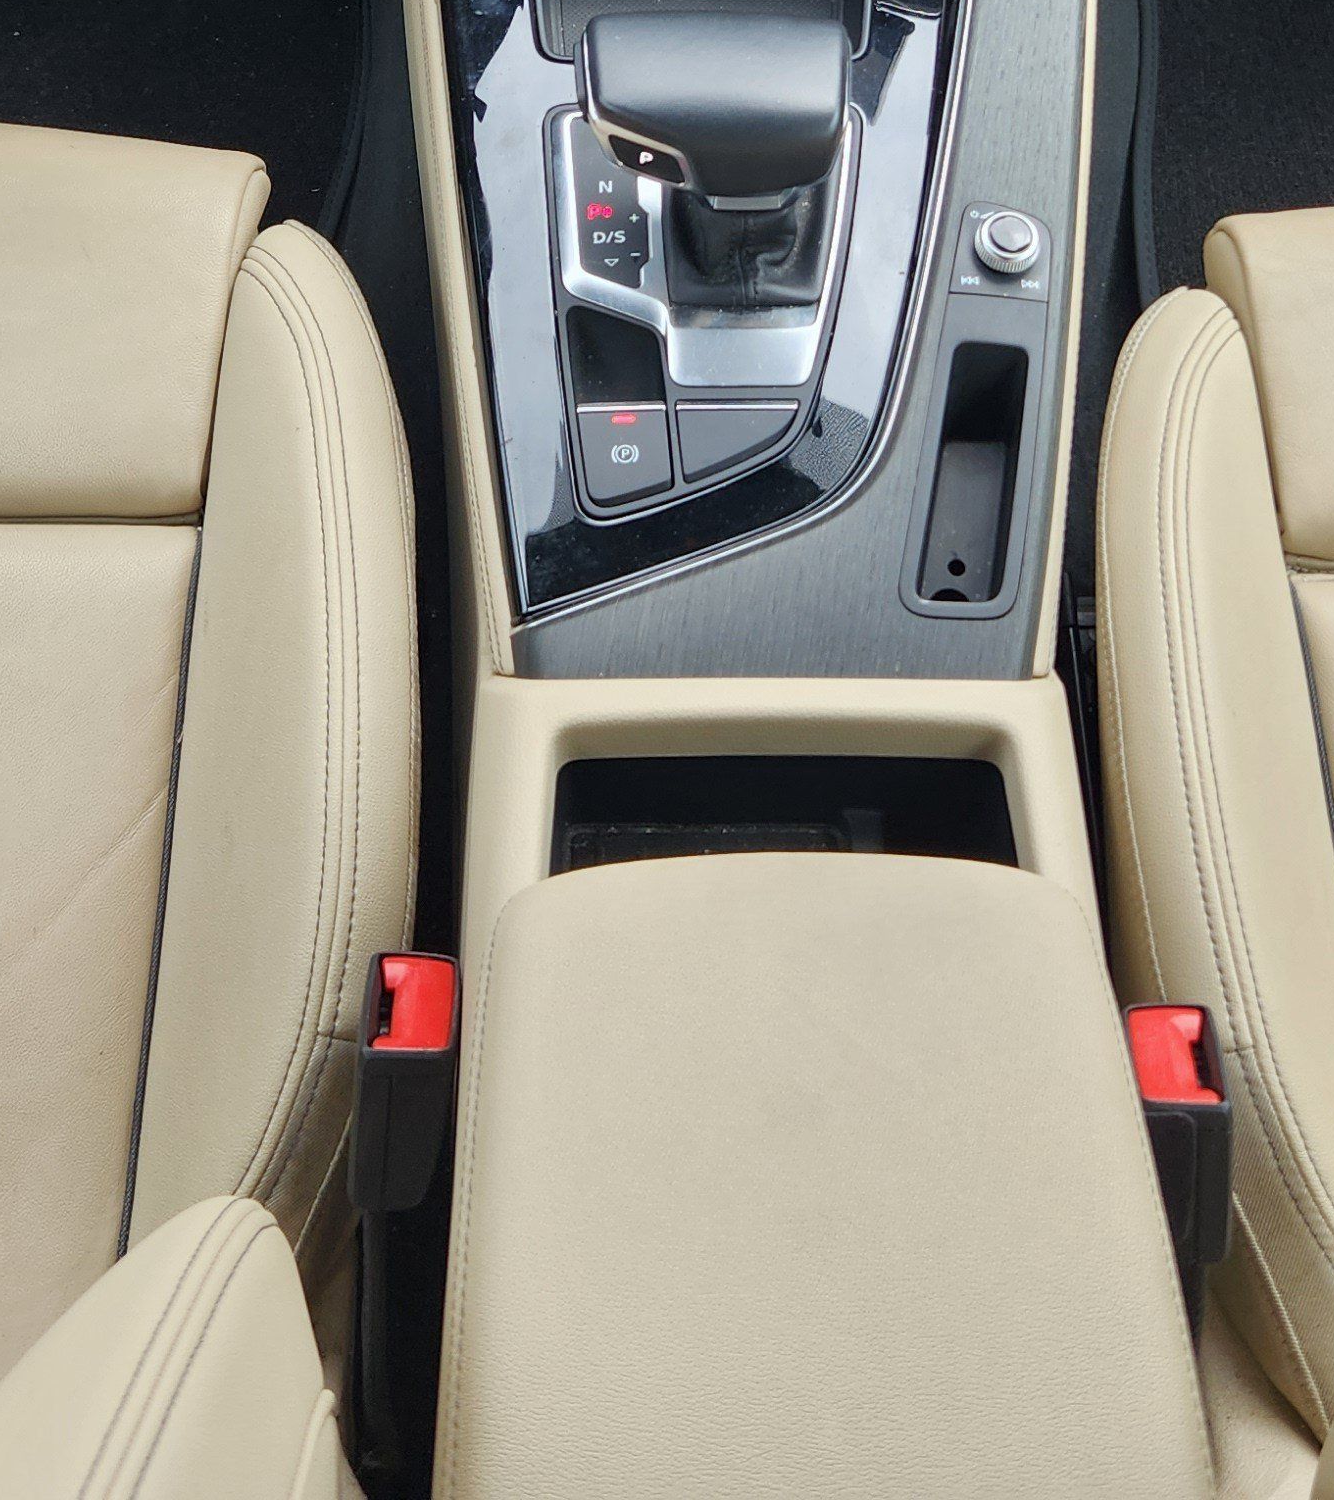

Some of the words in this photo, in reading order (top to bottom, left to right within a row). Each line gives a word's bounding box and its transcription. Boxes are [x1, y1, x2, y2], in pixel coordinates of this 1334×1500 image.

[639, 151, 654, 165] P
[599, 180, 613, 193] N
[592, 230, 627, 244] D/S
